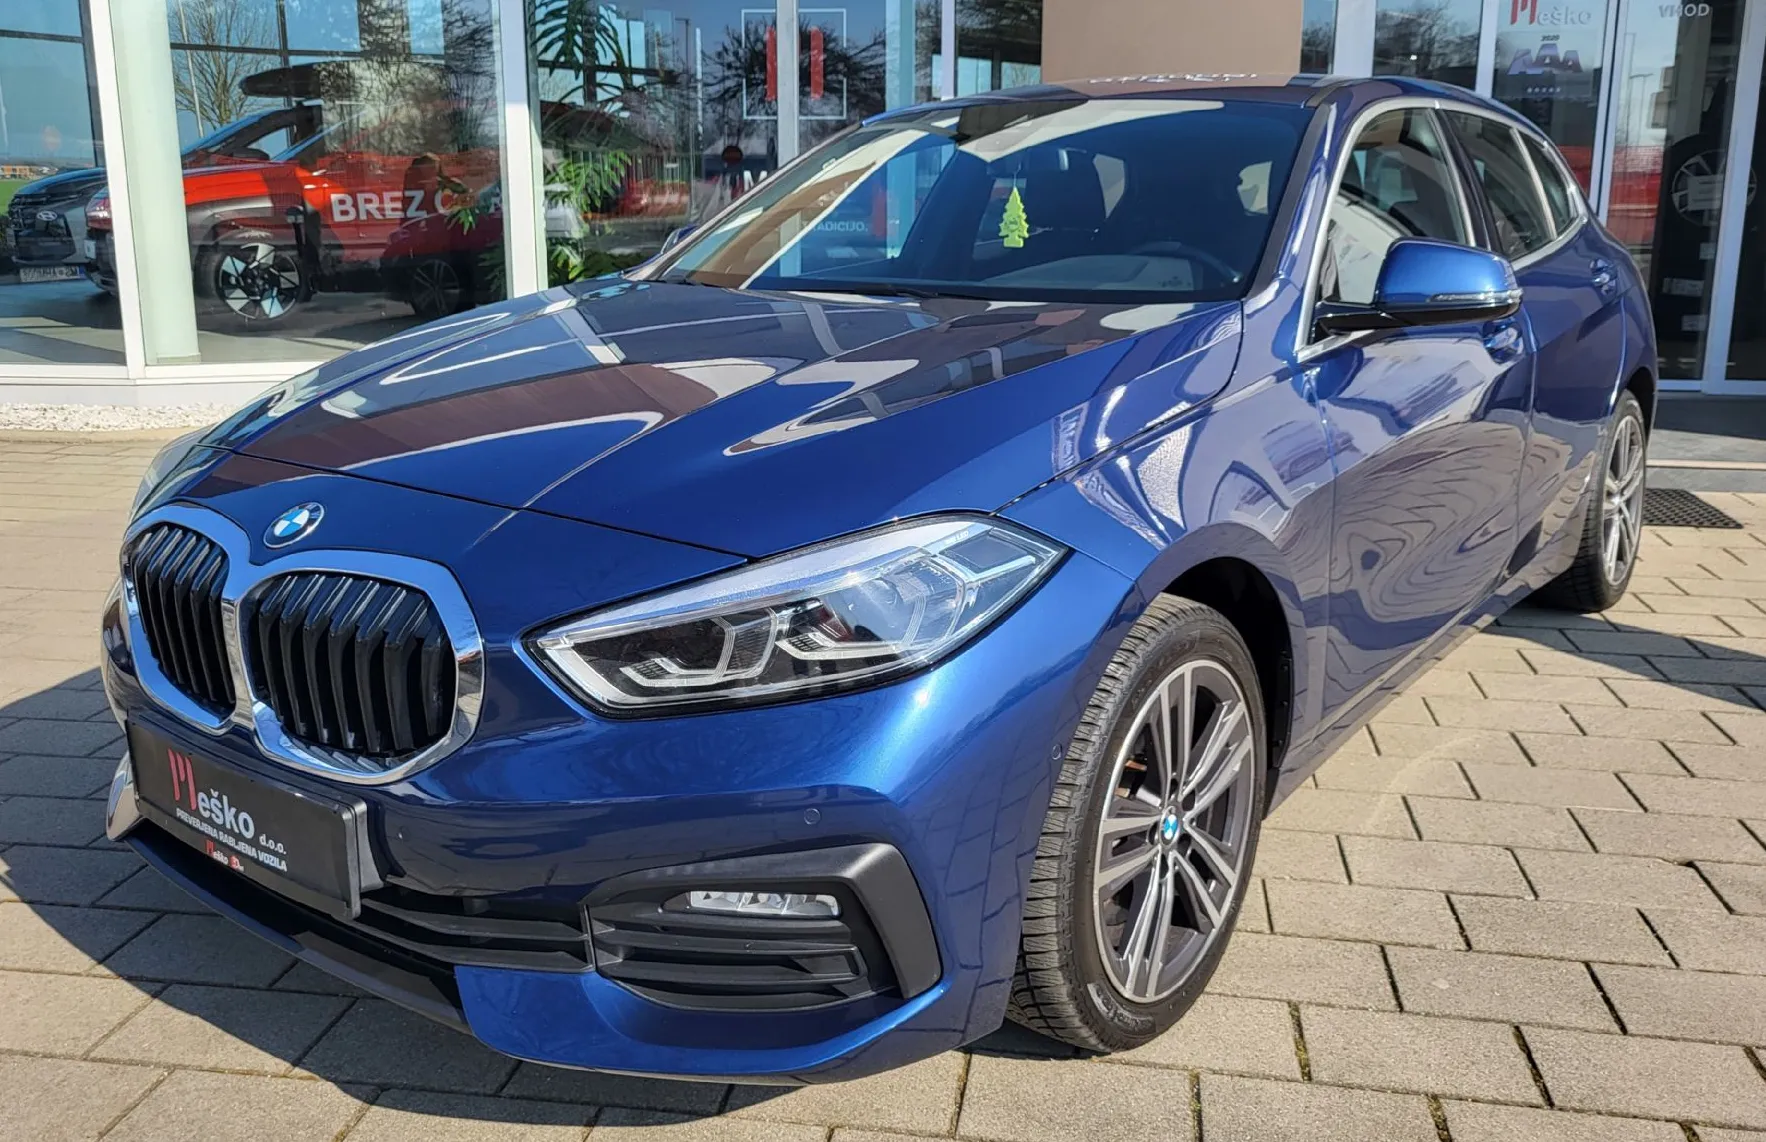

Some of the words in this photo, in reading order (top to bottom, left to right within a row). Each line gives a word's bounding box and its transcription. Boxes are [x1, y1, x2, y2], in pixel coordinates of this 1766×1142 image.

[1658, 3, 1710, 18] VHOD
[330, 189, 428, 222] BREZ
[167, 747, 255, 840] Meško
[259, 834, 287, 855] d.o.o.
[176, 807, 219, 840] PREVERJENA
[219, 831, 257, 860] RABLJENA
[257, 849, 288, 872] VOZILA
